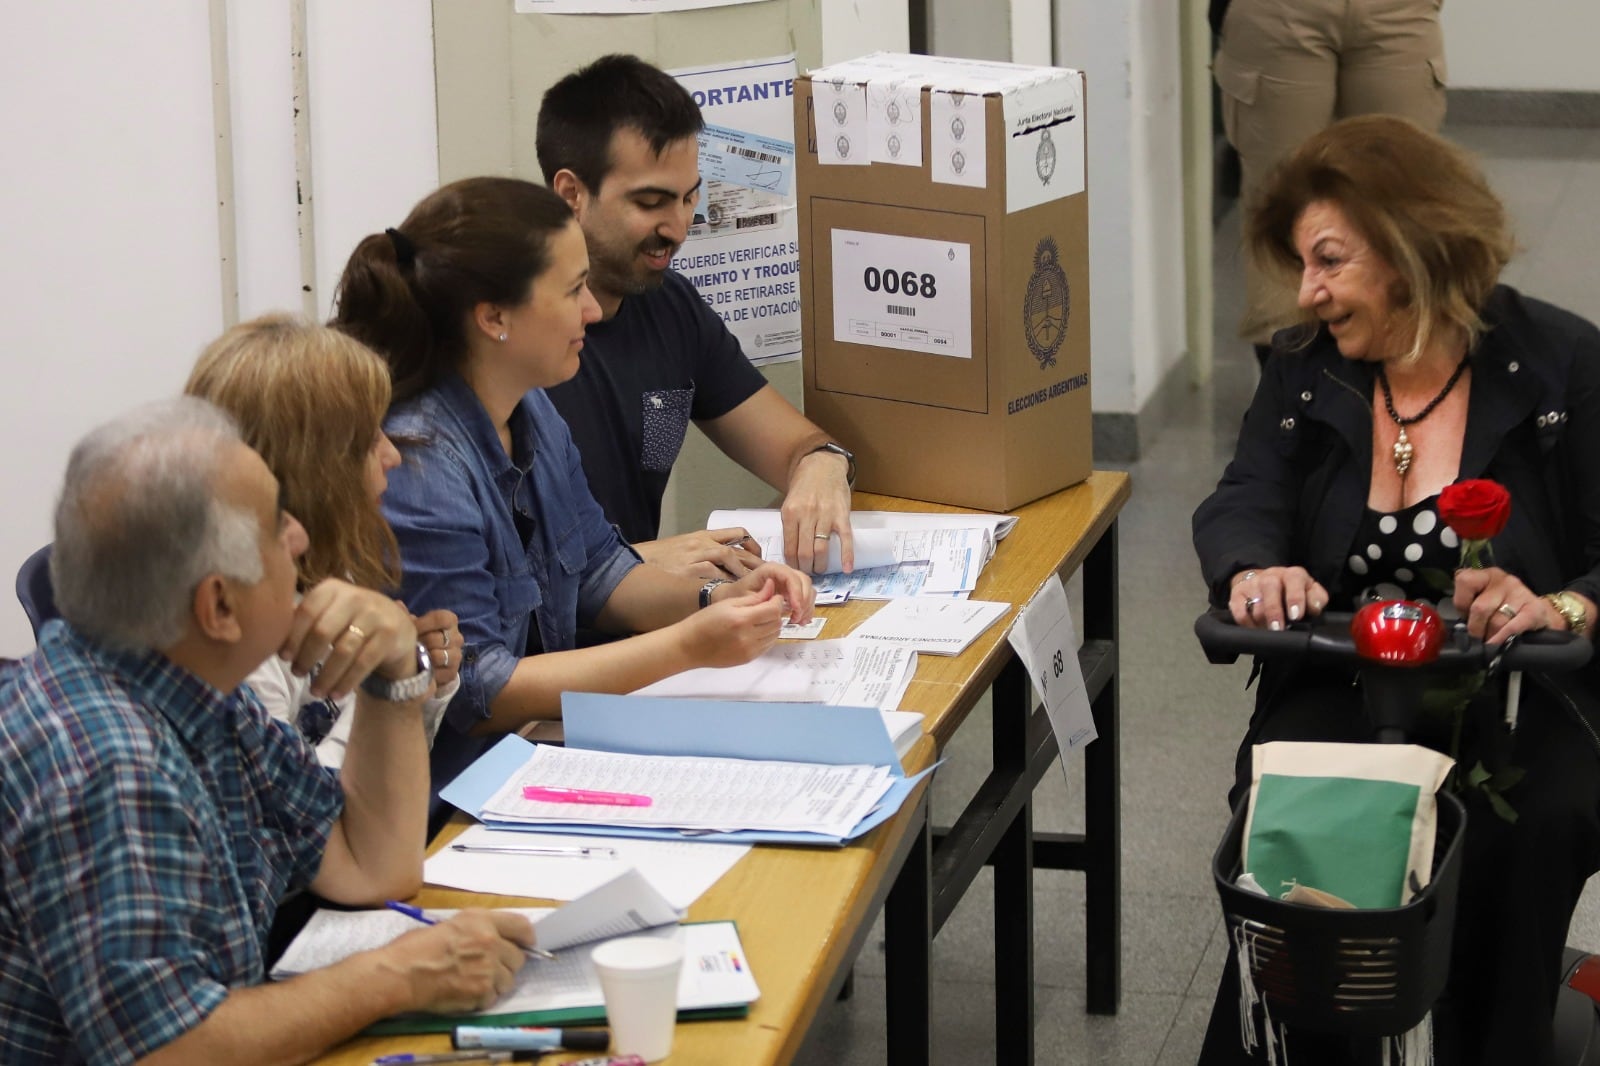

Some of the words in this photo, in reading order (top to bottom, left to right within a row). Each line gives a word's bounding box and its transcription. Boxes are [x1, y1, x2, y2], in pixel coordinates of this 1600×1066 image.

[1017, 117, 1031, 127] Junta
[1031, 110, 1053, 122] Electoral
[1053, 105, 1073, 115] Nacional
[670, 252, 727, 271] ECUERDE
[728, 244, 786, 263] VERIFICAR
[689, 270, 738, 288] MENTO
[742, 268, 750, 280] Y
[863, 266, 937, 299] 0068
[717, 291, 732, 304] DE
[735, 281, 796, 300] RETIRARSE
[734, 308, 749, 322] DE
[1008, 388, 1047, 415] ELECCIONES
[1049, 372, 1088, 399] ARGENTINAS
[1053, 649, 1064, 679] 68
